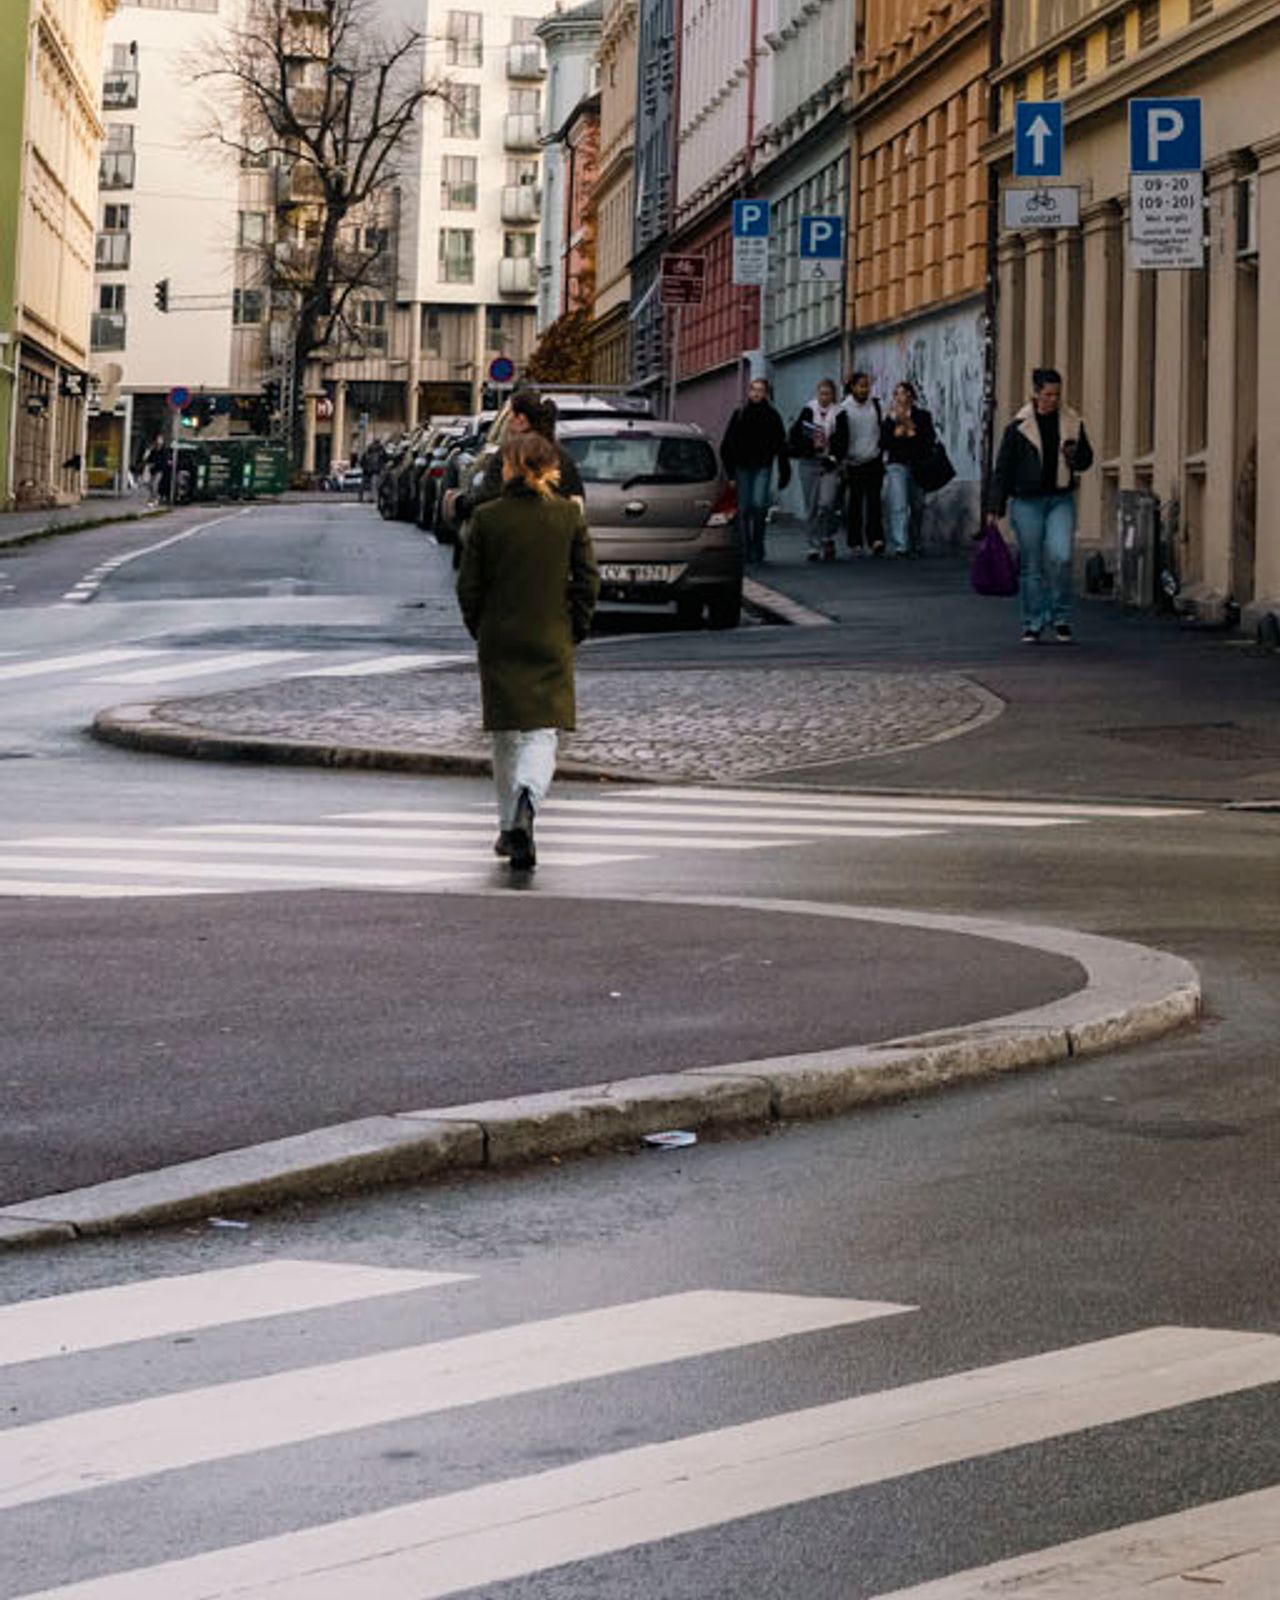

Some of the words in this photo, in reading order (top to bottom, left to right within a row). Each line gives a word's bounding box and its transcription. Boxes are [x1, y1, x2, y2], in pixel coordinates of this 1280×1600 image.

[1147, 108, 1184, 162] P
[742, 205, 761, 232] P
[809, 221, 832, 253] P
